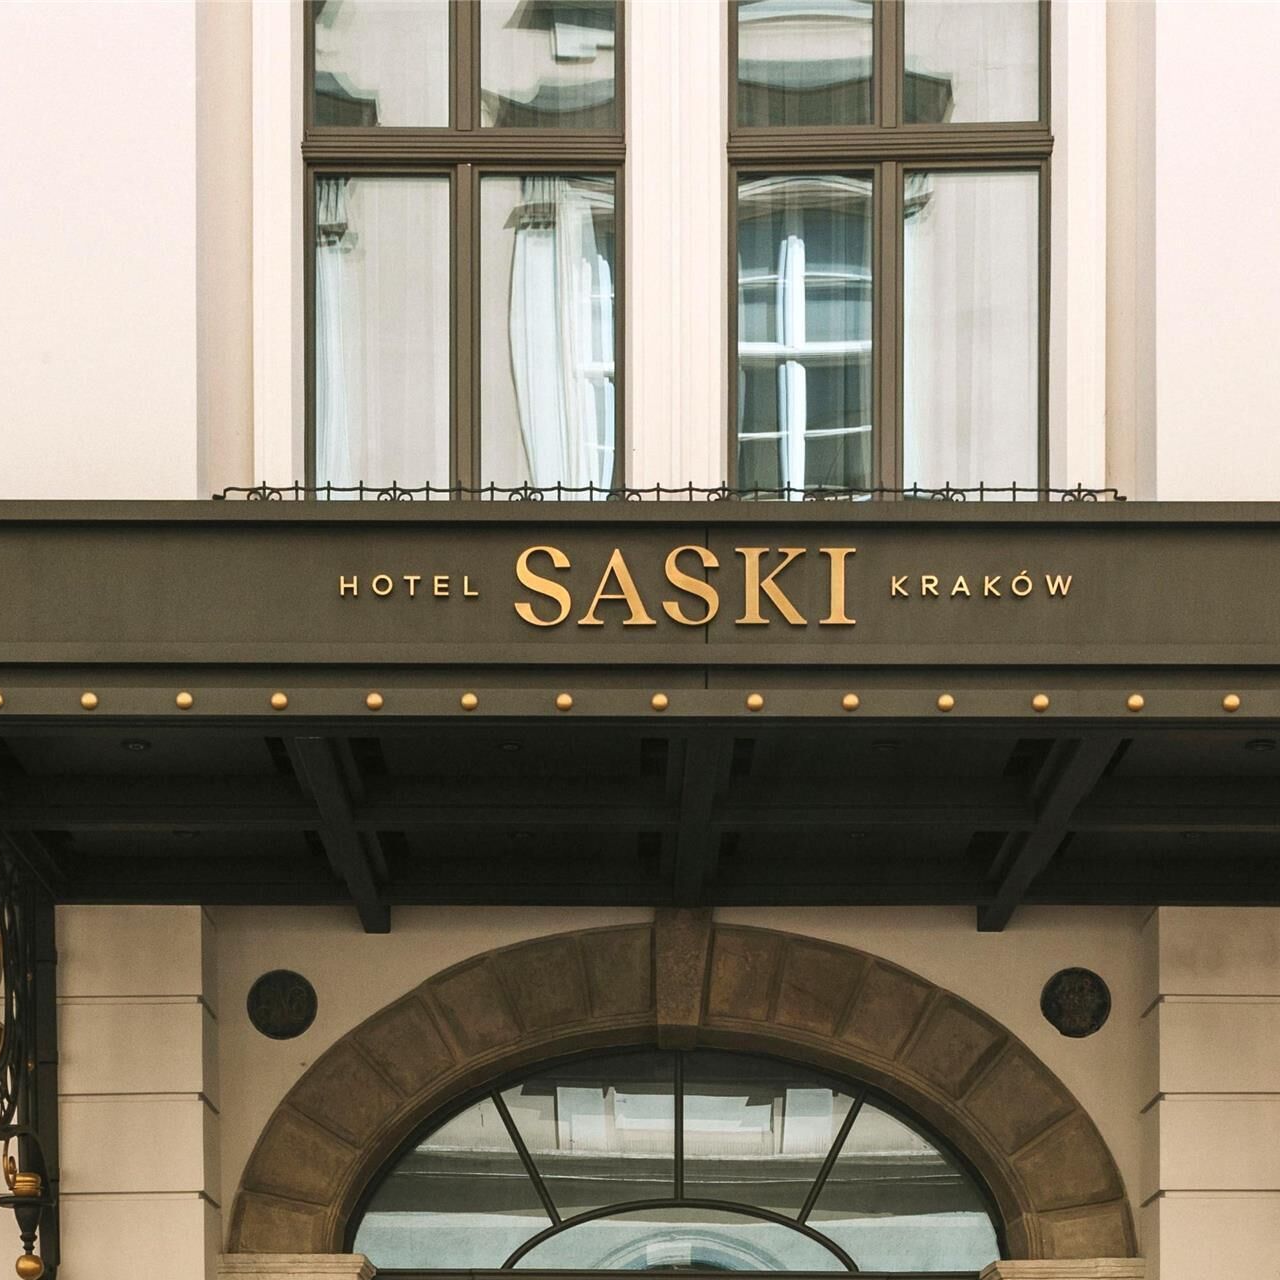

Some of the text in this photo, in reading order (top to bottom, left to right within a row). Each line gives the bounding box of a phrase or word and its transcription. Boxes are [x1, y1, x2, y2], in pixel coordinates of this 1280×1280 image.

[339, 544, 1073, 627] HOTEL SASKI KRAKÓW
